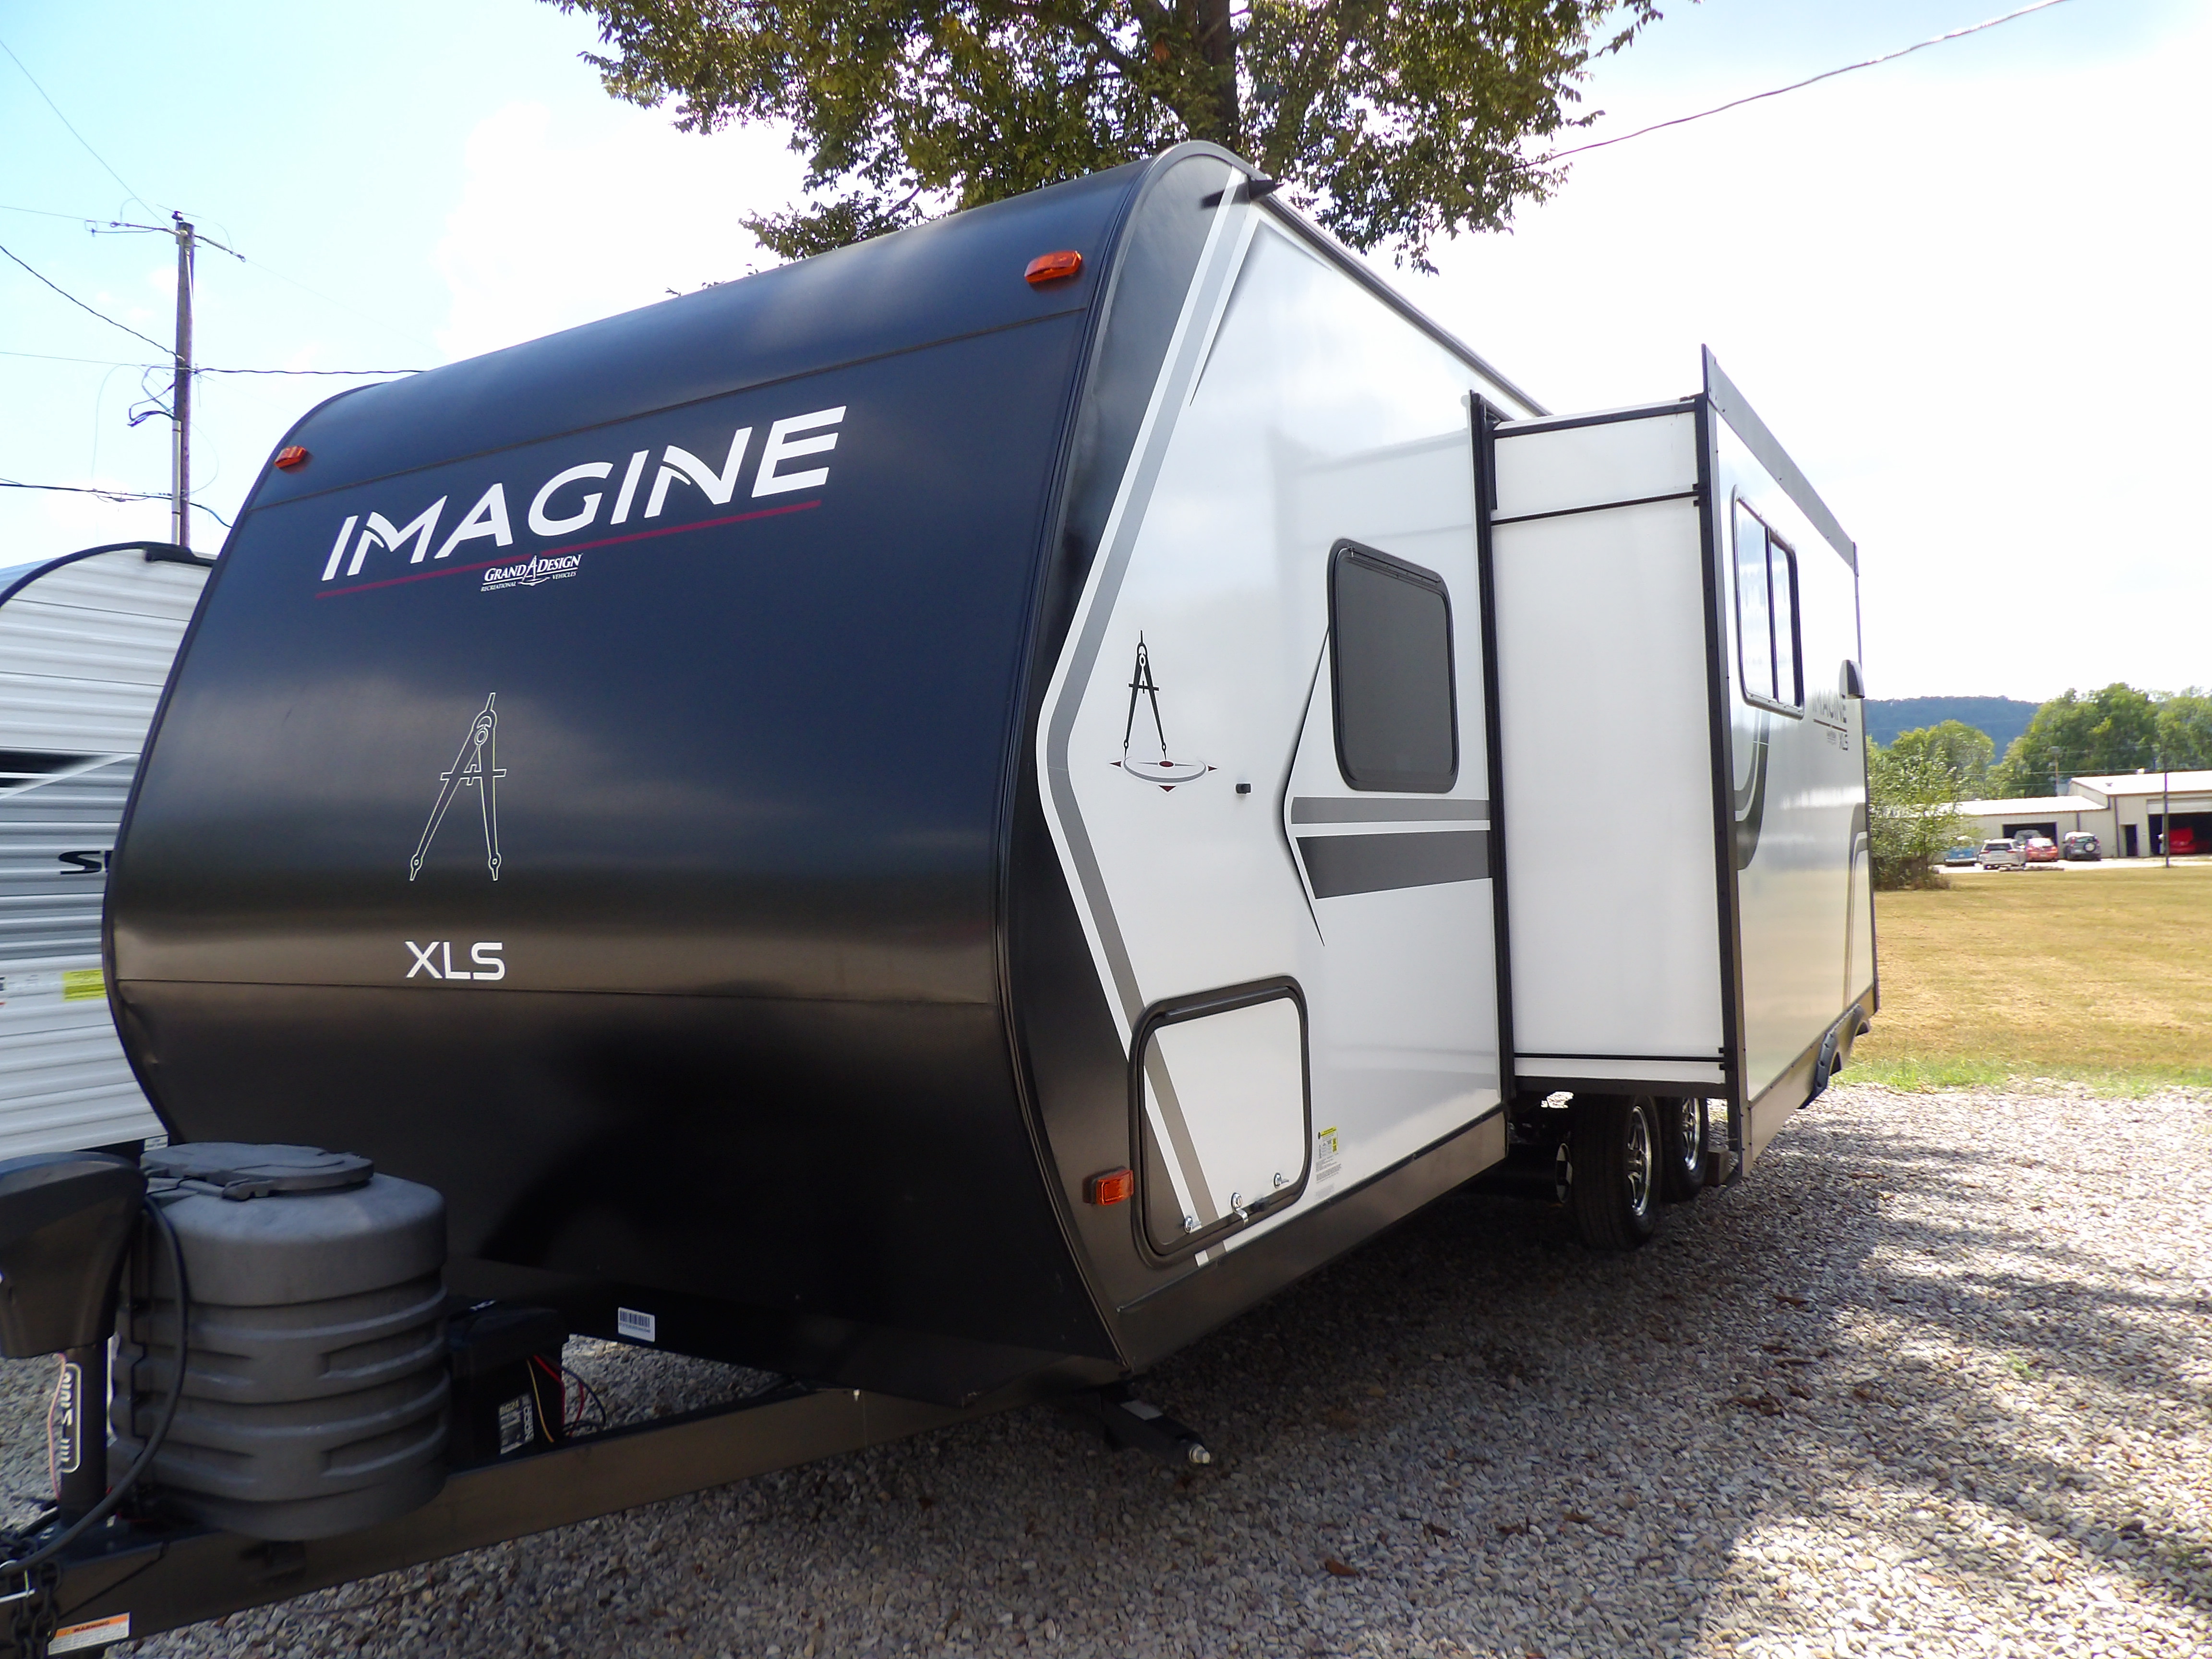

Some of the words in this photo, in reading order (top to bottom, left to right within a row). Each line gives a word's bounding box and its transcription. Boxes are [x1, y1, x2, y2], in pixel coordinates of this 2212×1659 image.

[322, 405, 847, 581] IMAGINE
[480, 581, 517, 592] RECREATIONAL
[552, 571, 577, 580] VEHICLES
[484, 564, 527, 582] GRAND
[537, 554, 582, 574] DESIGN
[404, 941, 505, 981] XLS
